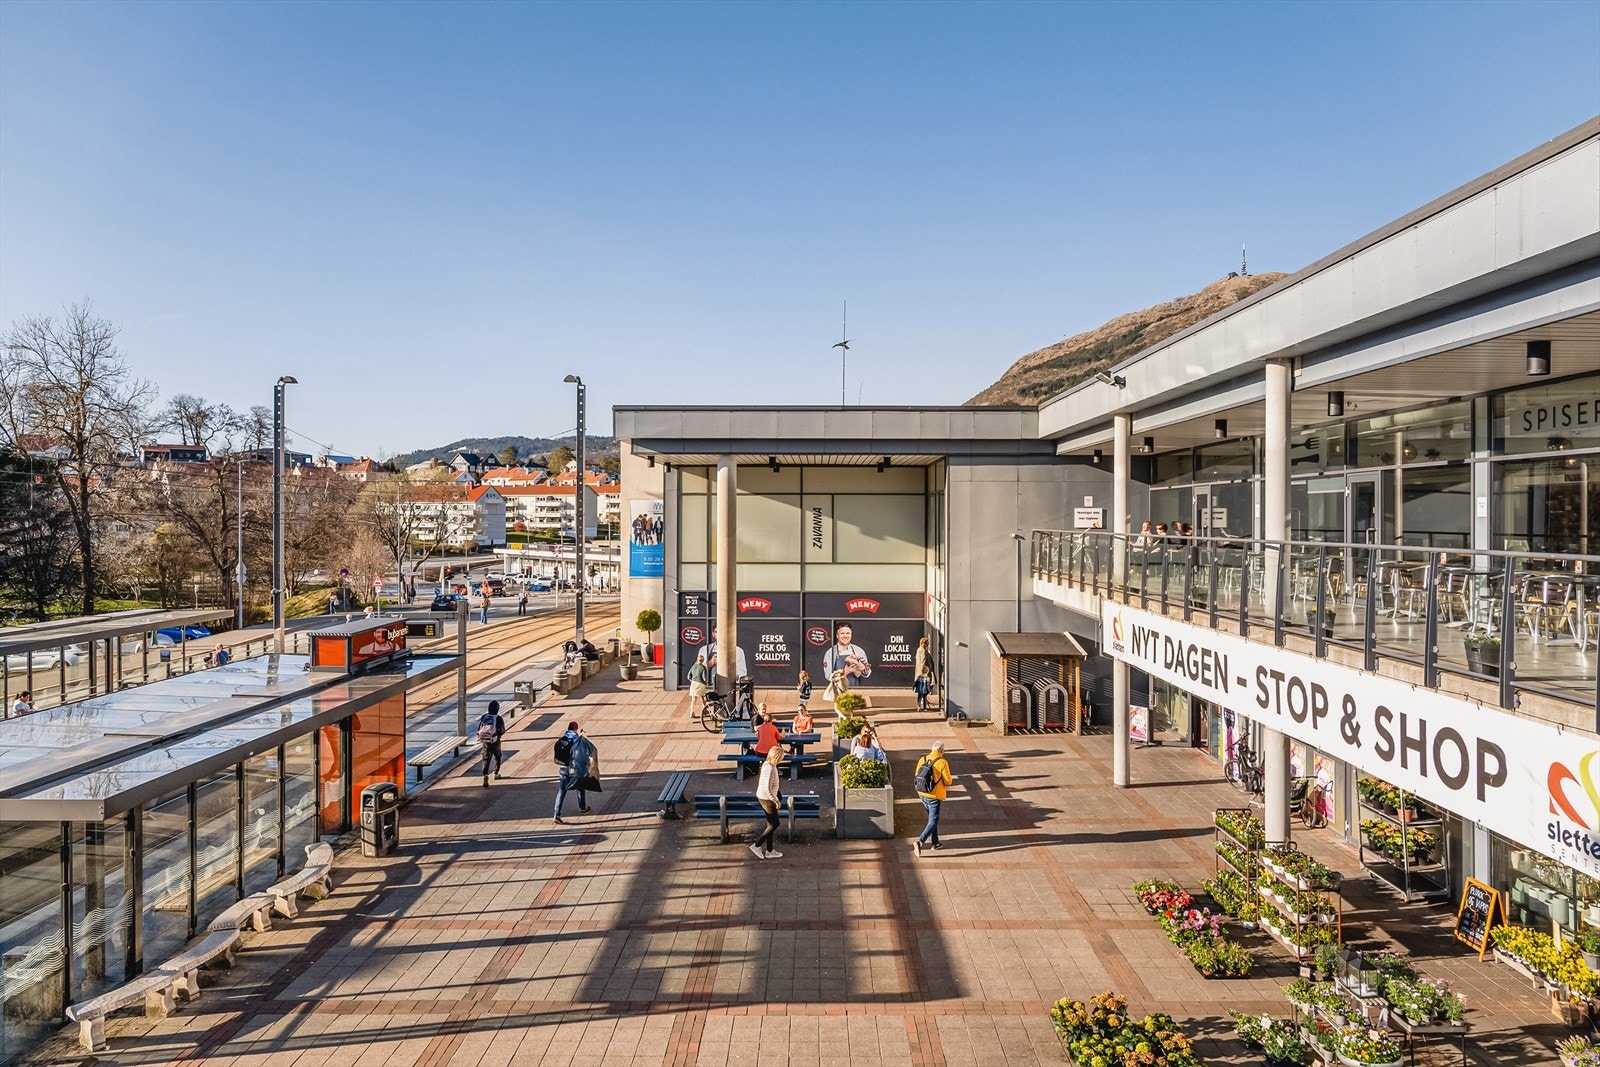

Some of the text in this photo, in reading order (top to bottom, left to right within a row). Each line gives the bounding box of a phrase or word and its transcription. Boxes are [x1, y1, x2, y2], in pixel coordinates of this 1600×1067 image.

[812, 507, 822, 549] ZAVANNA
[741, 600, 768, 609] MENY
[850, 601, 876, 610] MENY
[762, 634, 784, 642] FERSK
[890, 636, 904, 644] DIN
[759, 644, 786, 652] FISK OG
[884, 644, 910, 652] LOKALE
[755, 652, 790, 660] SKALLDYR
[882, 654, 912, 662] SLAKTER
[1132, 624, 1160, 664] NYT
[1164, 635, 1229, 694] DAGEN
[1256, 665, 1328, 730] STOP
[1340, 693, 1361, 748] &
[1374, 705, 1508, 803] SHOP
